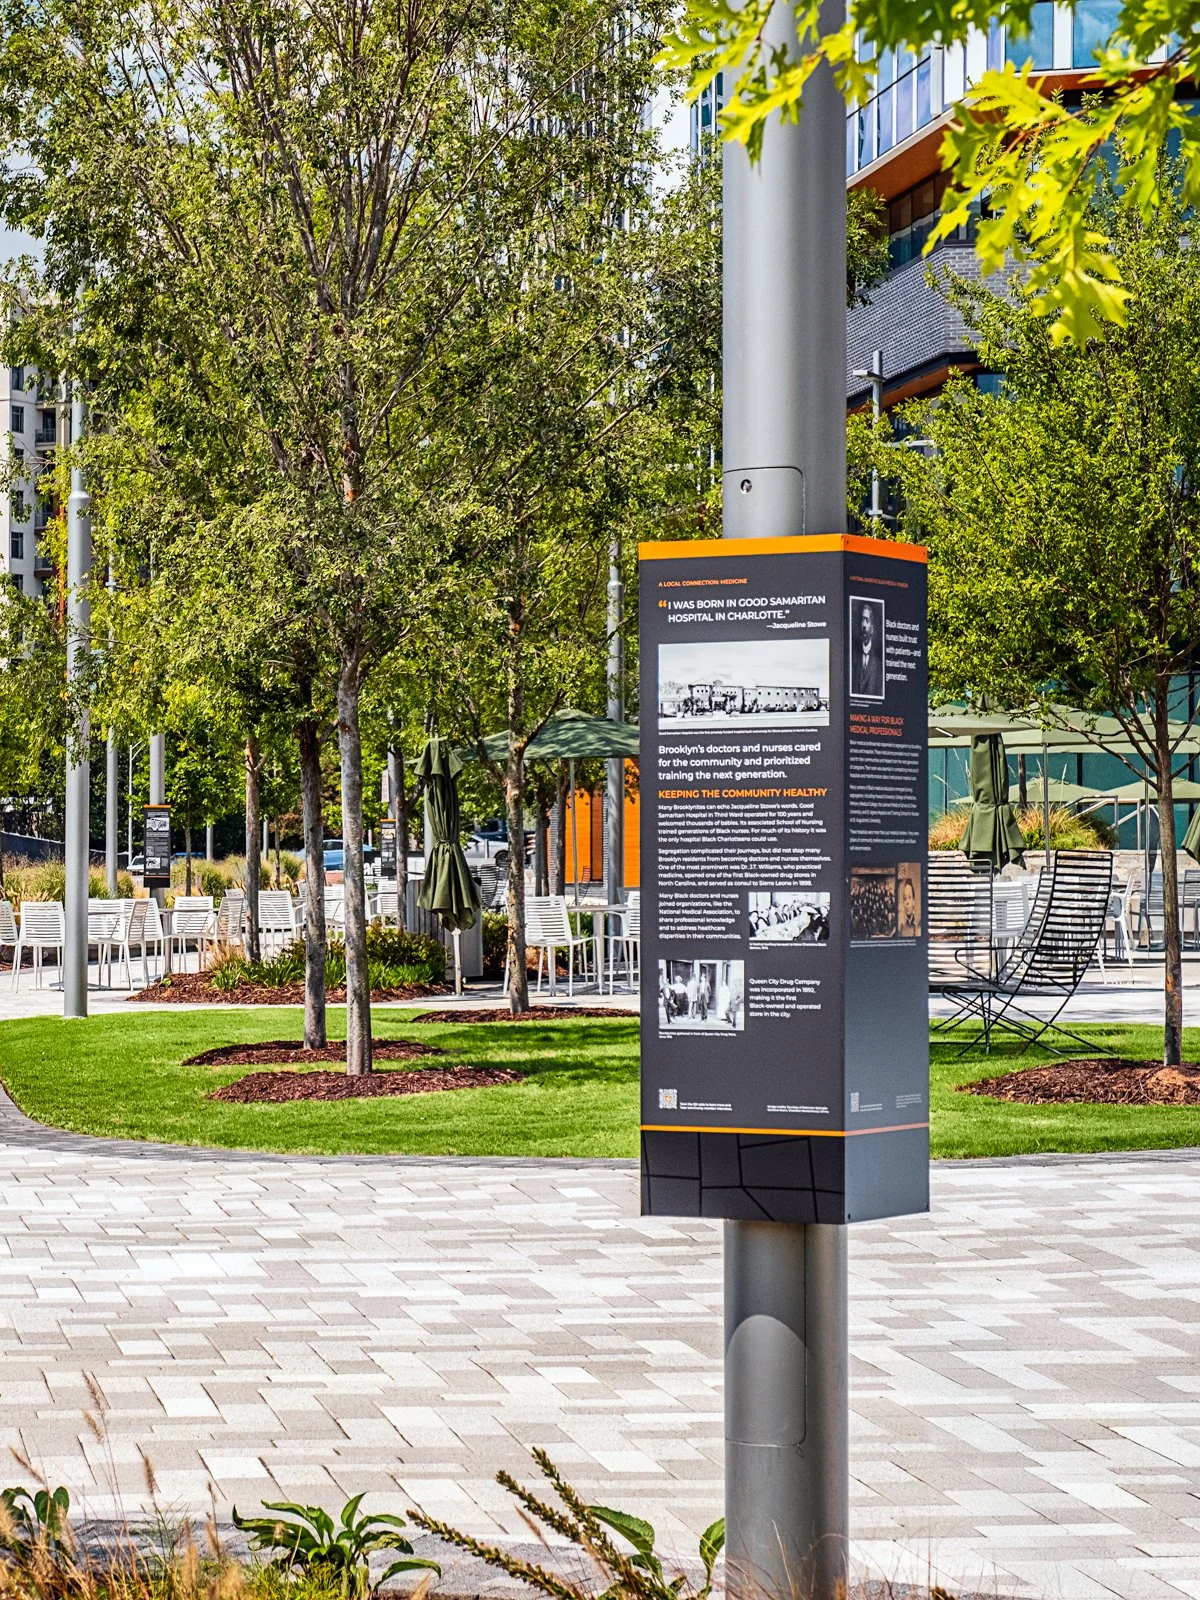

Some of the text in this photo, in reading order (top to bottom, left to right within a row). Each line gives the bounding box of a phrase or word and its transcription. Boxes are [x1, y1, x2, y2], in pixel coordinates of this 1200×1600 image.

[672, 600, 694, 610] WAS
[696, 599, 724, 609] BORN
[725, 599, 736, 608] IN
[737, 598, 768, 608] GOOD
[769, 595, 826, 606] SAMARITAN
[668, 610, 790, 623] HOSPITAL IN CHARLOTTE.”
[849, 715, 867, 723] MAKING
[870, 716, 881, 724] WAY
[880, 716, 890, 724] FOR
[889, 717, 904, 725] BLACK
[849, 725, 903, 737] MEDICAL PROFESSIONALS
[705, 744, 740, 753] doctors
[741, 743, 760, 753] and
[794, 742, 821, 752] cared
[658, 756, 811, 768] for the community and prioritized
[658, 770, 788, 782] training the next generation.
[658, 789, 828, 799] KEEPING THE COMMUNITY HEALTHY
[659, 900, 675, 908] joined
[767, 979, 779, 987] City
[779, 979, 794, 987] Drug
[794, 979, 821, 987] Company
[795, 1003, 822, 1011] operated
[779, 1011, 792, 1019] city.
